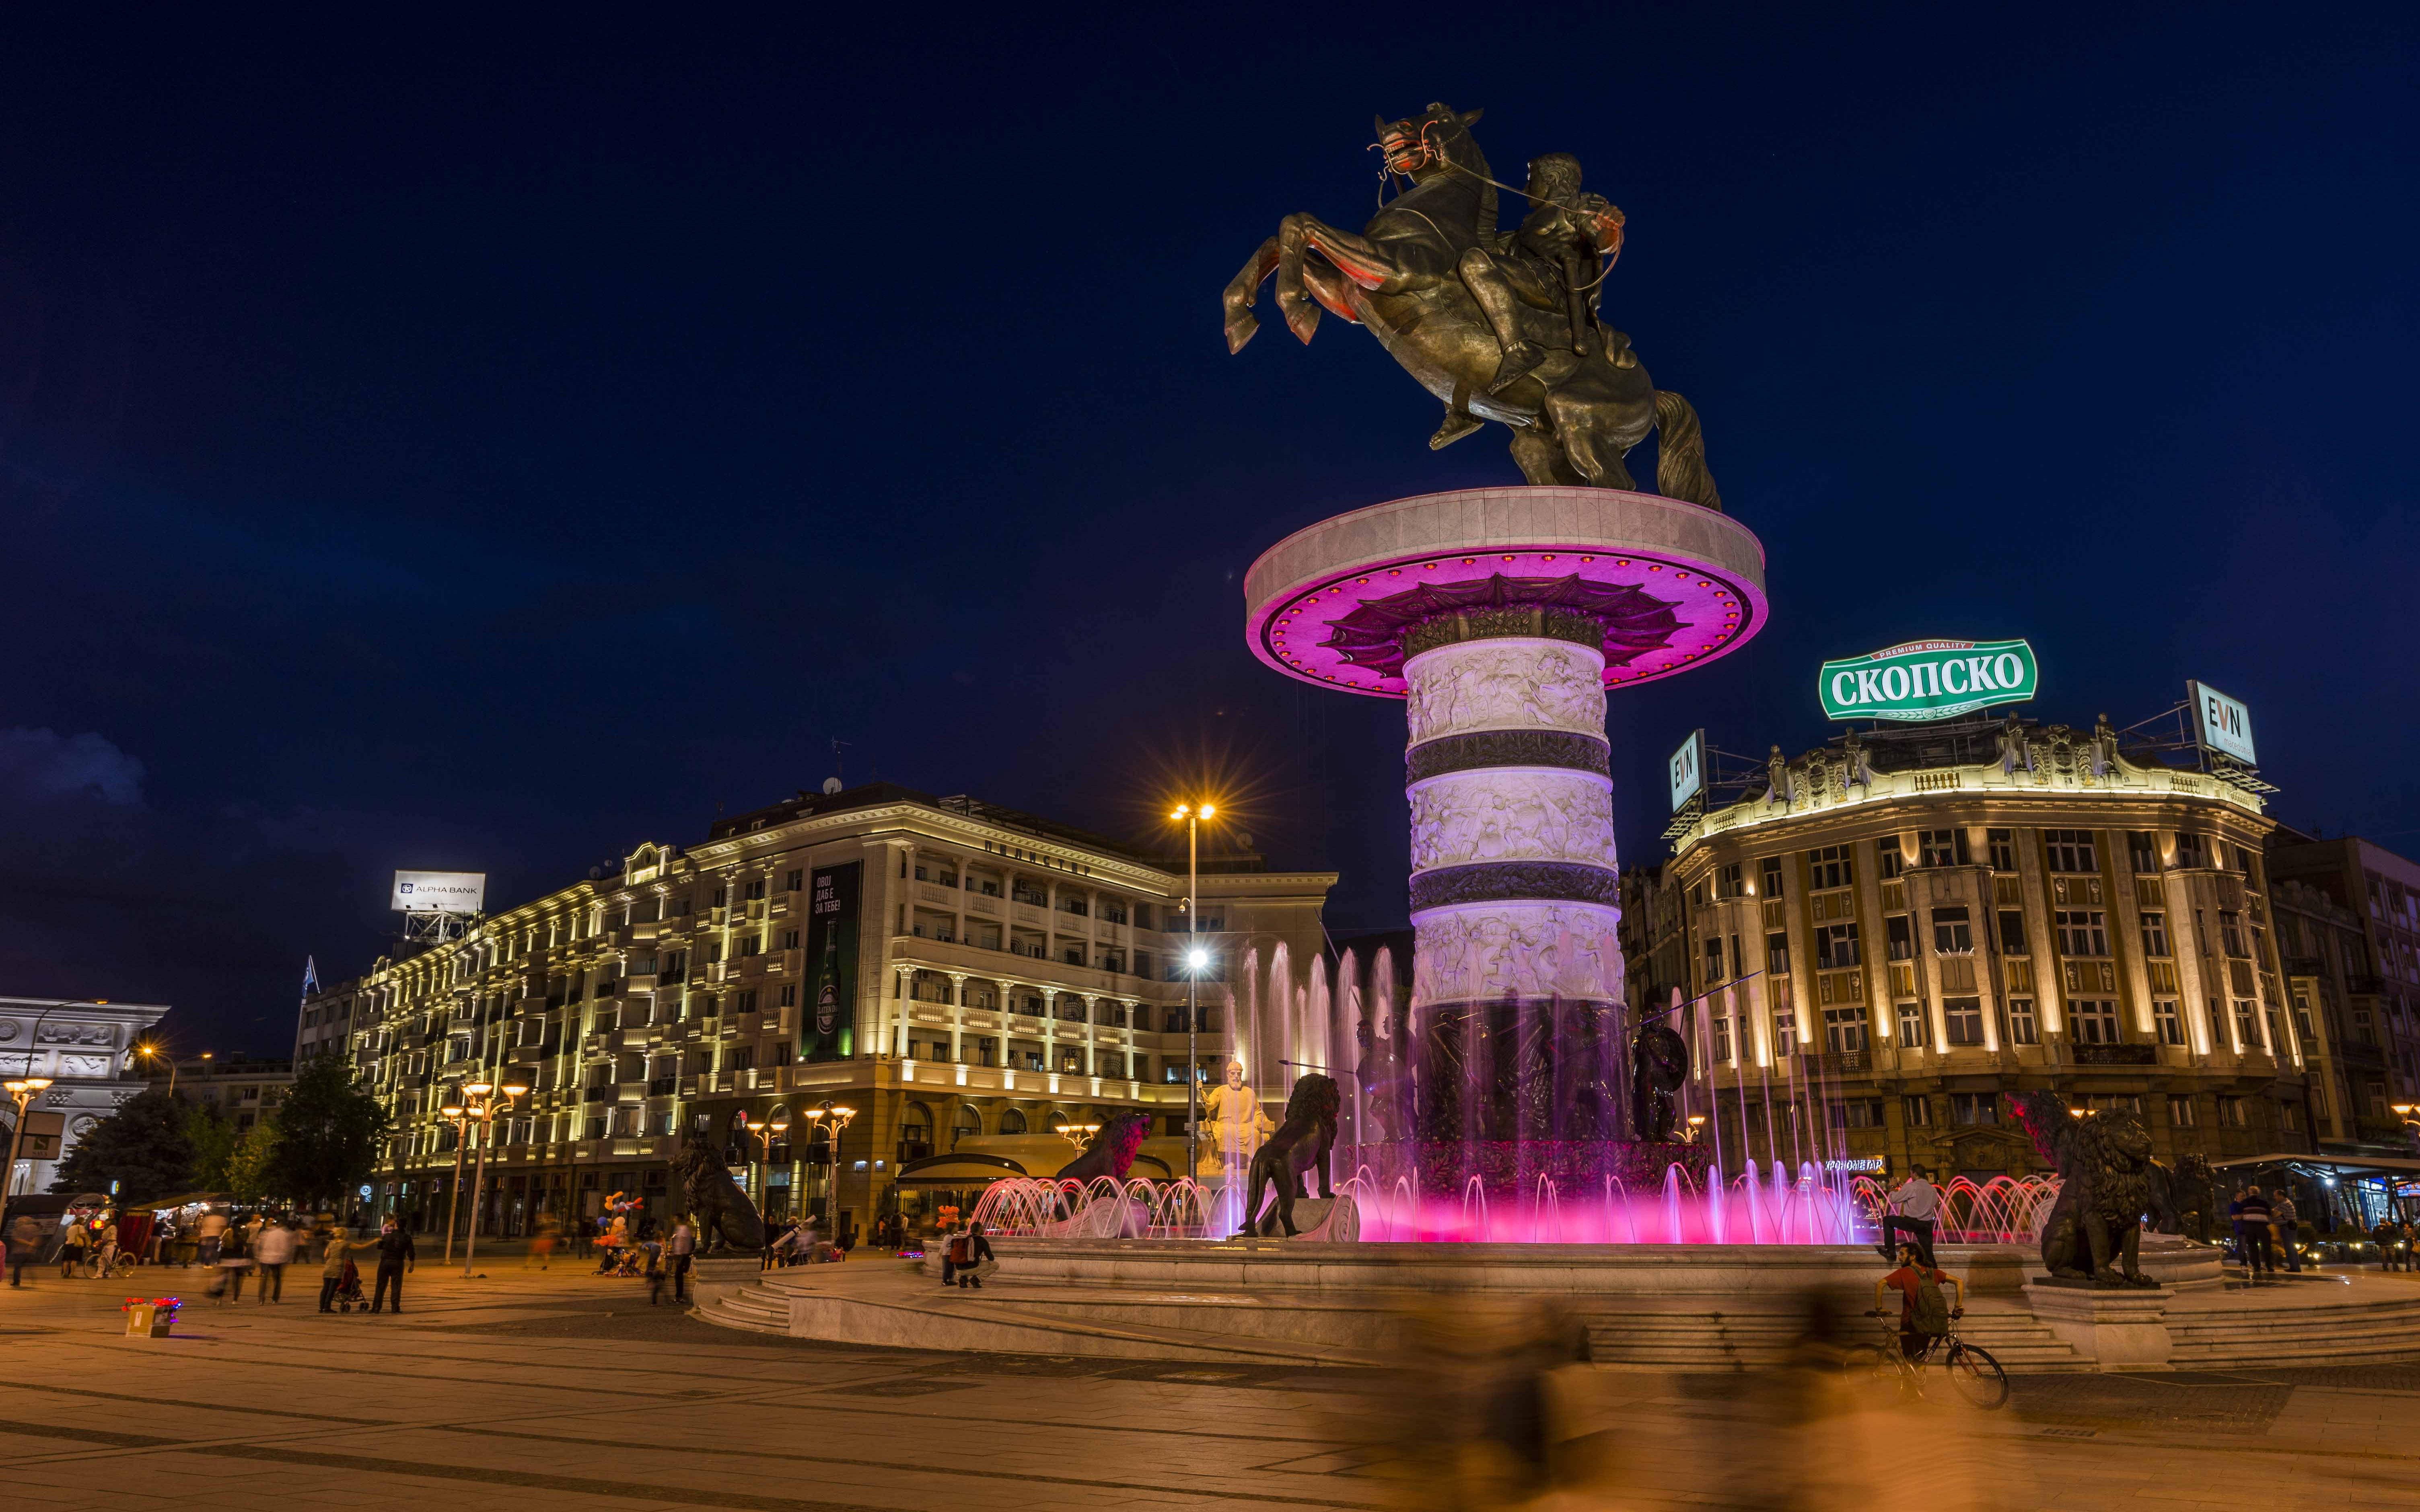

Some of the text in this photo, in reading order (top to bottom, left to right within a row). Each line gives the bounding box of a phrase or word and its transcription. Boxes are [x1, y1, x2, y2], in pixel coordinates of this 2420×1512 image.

[1879, 644, 1922, 658] PREMIUM
[1831, 653, 2025, 706] СКОПСКО
[2208, 696, 2241, 738] EVN
[2224, 738, 2251, 756] macedonia
[1675, 745, 1692, 790] EVN
[985, 840, 1091, 876] ПЕЛИСТЕР
[817, 875, 831, 887] ОВОЈ
[816, 889, 829, 902] ДАБ
[815, 899, 840, 914] ЗА ТЕБЕ!
